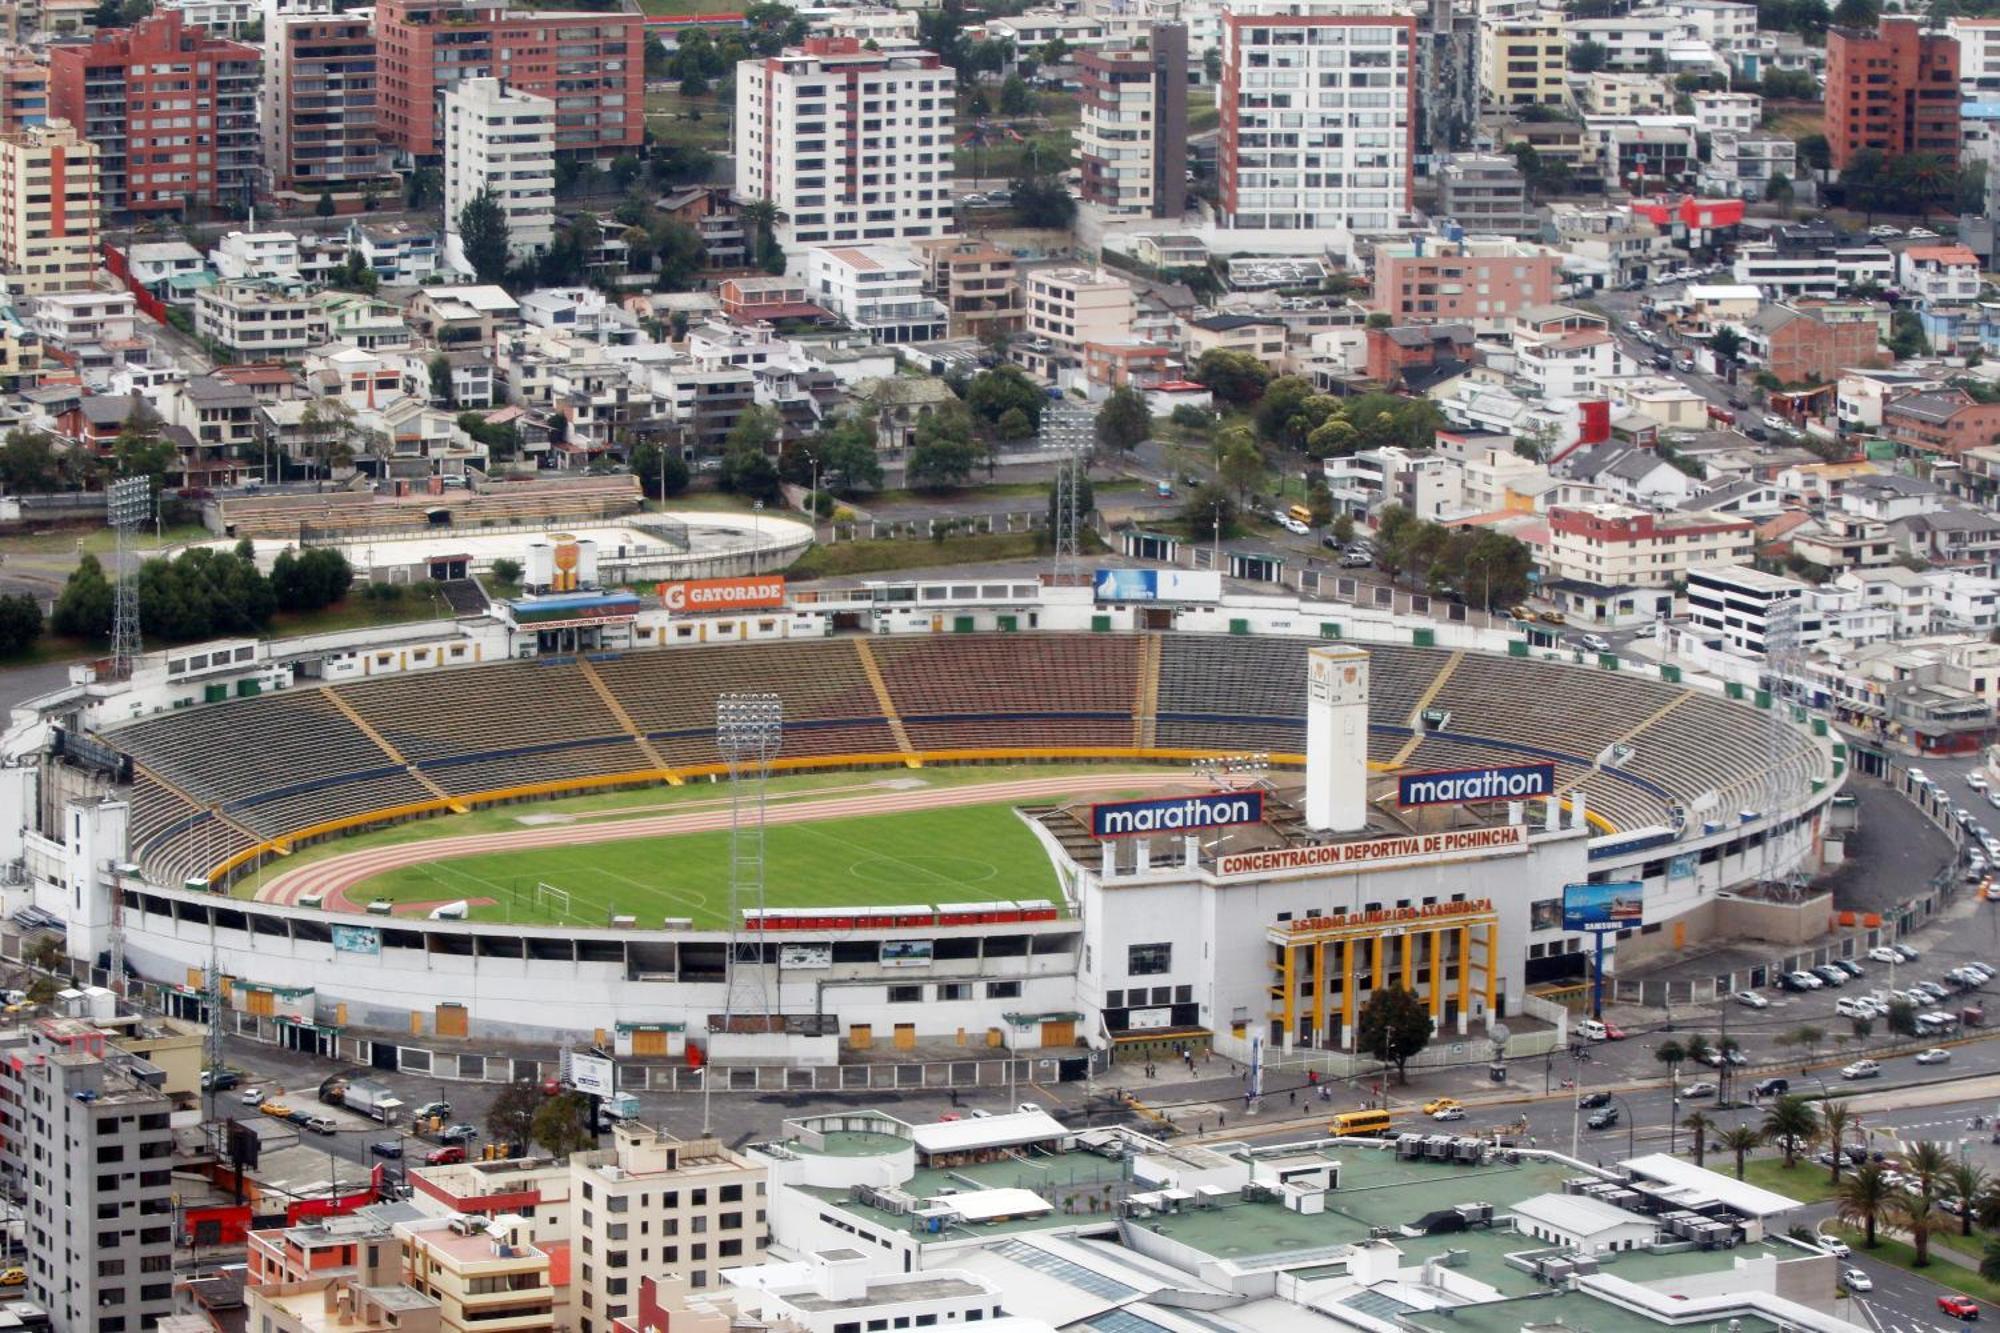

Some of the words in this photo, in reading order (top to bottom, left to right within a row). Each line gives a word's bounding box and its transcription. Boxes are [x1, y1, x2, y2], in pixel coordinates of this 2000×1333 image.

[690, 585, 781, 602] GATORADE
[1409, 771, 1543, 803] marathon
[1104, 800, 1250, 833] marathon
[1223, 849, 1340, 873] CONCENTRACION
[1345, 839, 1420, 862] DEPORTIVA
[1424, 837, 1442, 851] DE
[1445, 829, 1520, 848] PICHINCHA
[1291, 915, 1346, 932] ESTADIO
[1349, 906, 1417, 926] OLIMPICO
[1420, 897, 1493, 918] ATAHUALPA
[1584, 921, 1623, 930] SAMSUNG
